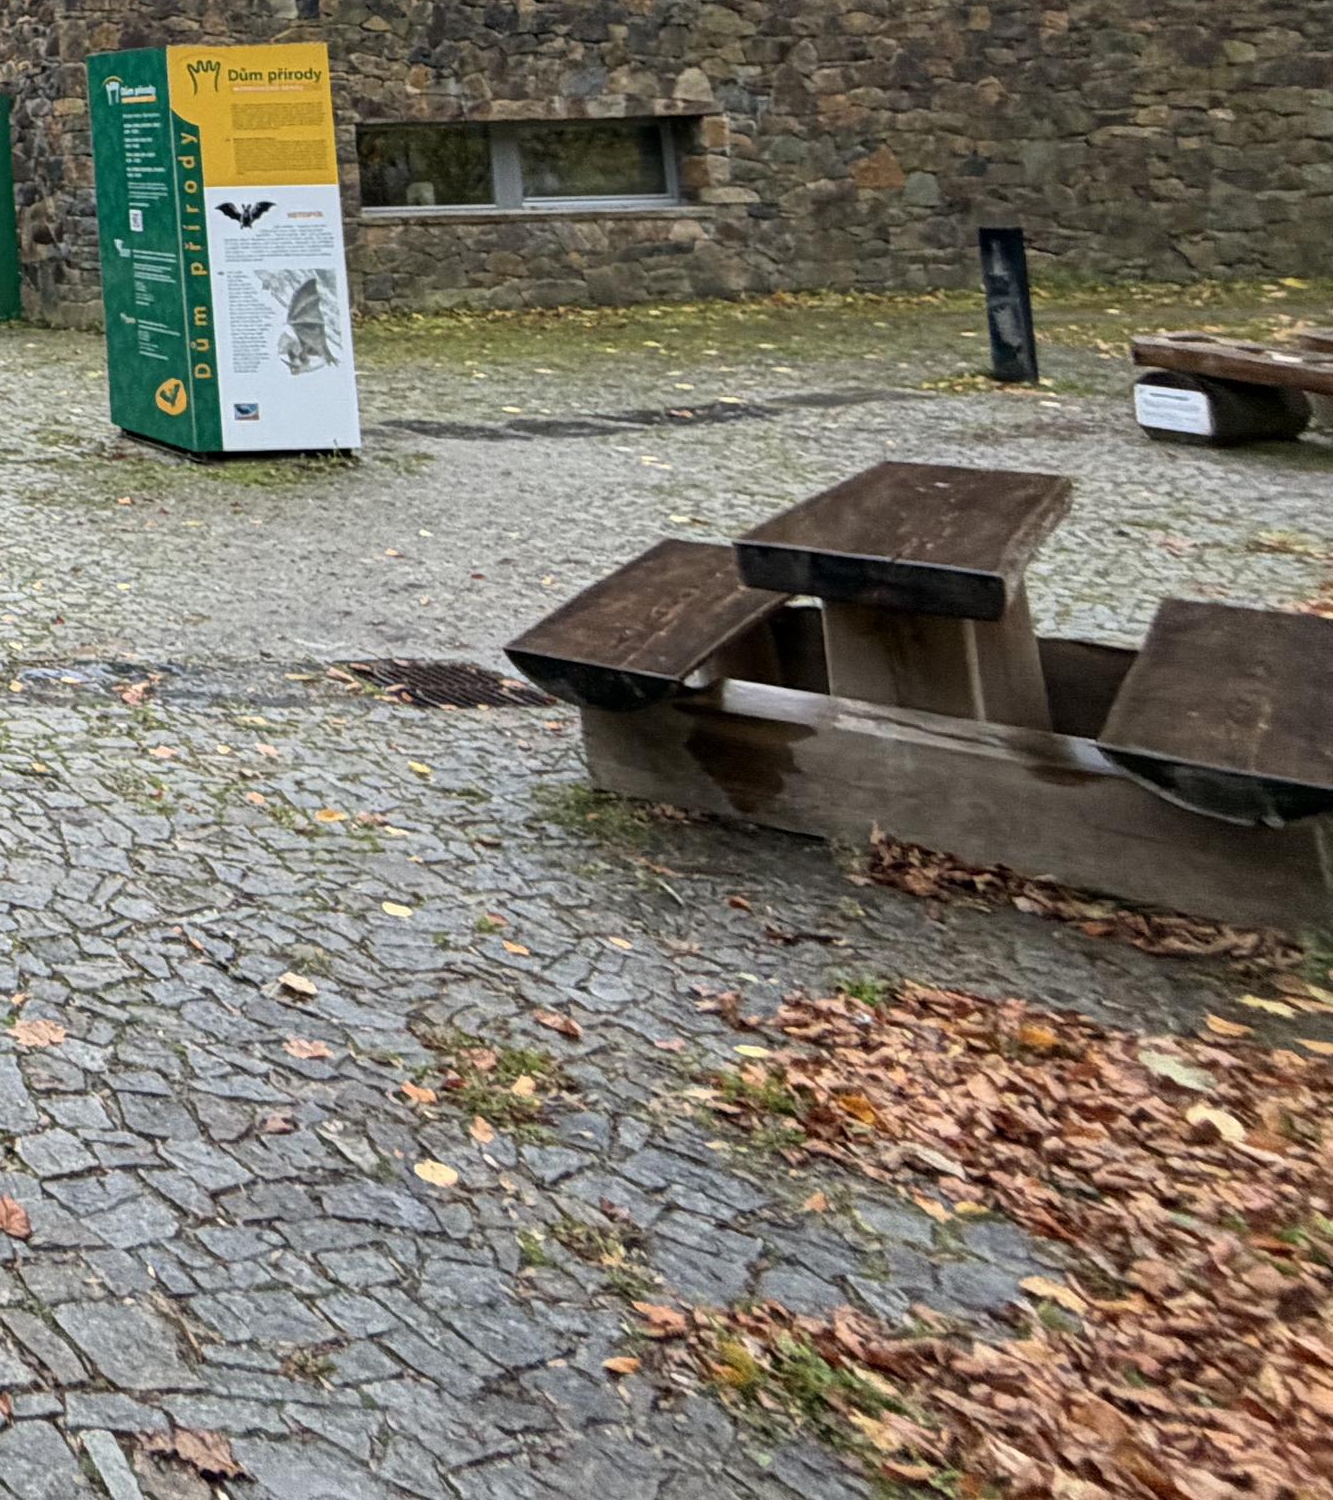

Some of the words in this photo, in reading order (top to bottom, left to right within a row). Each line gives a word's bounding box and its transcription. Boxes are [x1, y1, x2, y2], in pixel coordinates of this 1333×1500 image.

[228, 67, 263, 82] Dům
[268, 67, 322, 84] přírody
[177, 132, 208, 276] přírody
[190, 306, 211, 380] Dům
